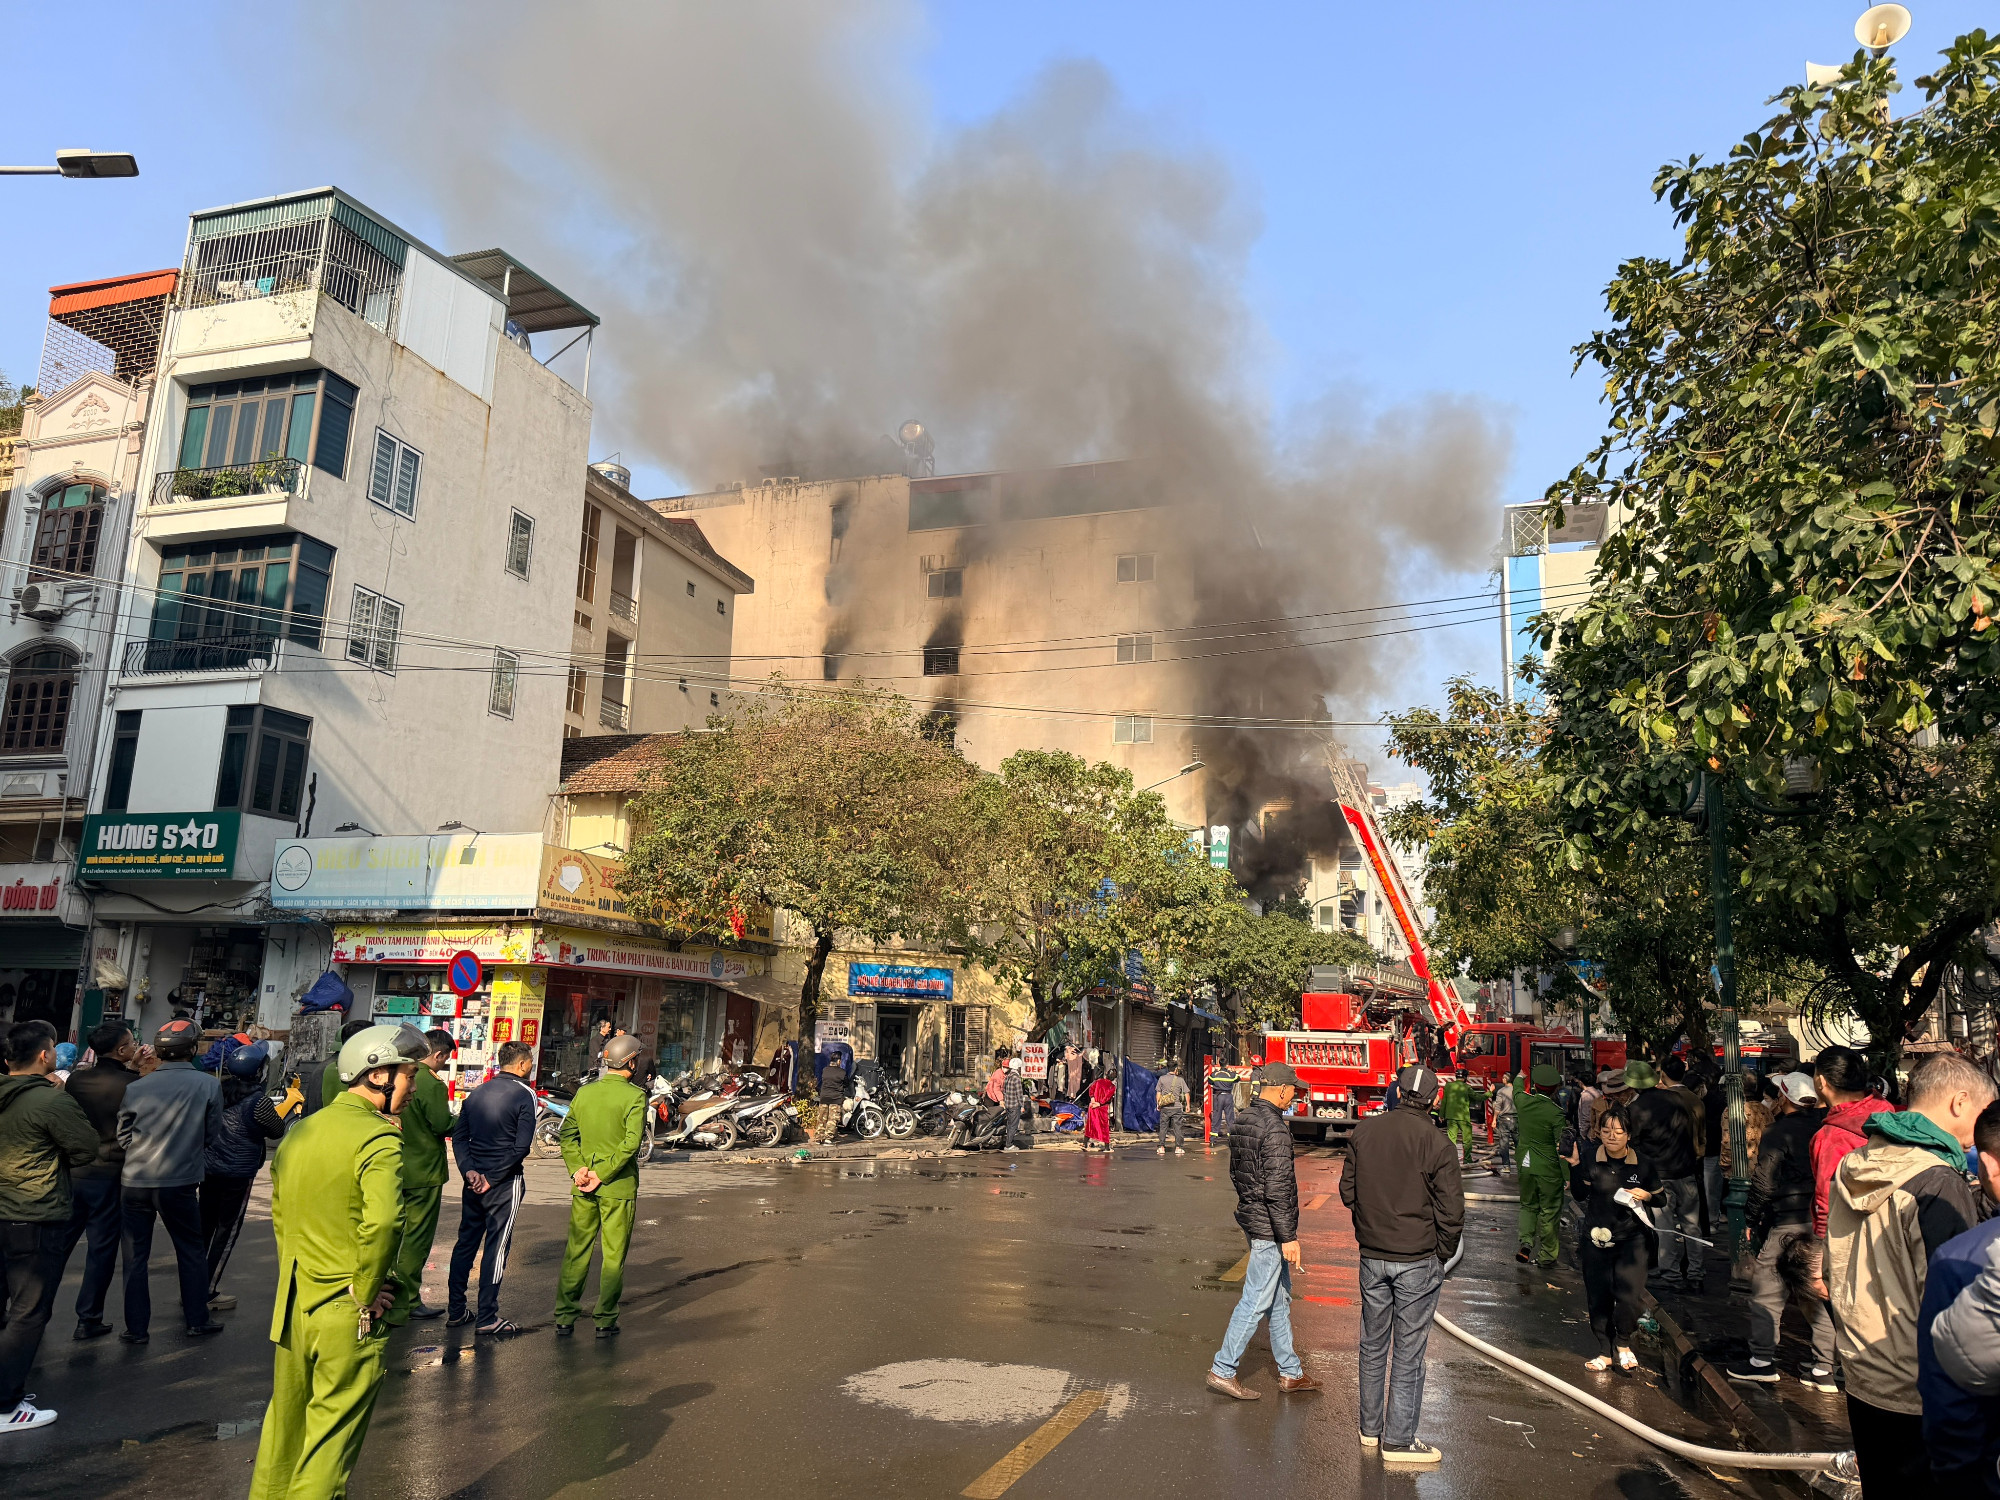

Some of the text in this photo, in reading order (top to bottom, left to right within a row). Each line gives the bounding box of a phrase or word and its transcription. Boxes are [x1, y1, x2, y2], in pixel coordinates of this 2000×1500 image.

[97, 822, 158, 850] HƯNG
[598, 895, 610, 911] BÁN
[365, 936, 386, 946] TRUNG
[388, 934, 402, 946] TÂM
[402, 934, 420, 946] PHÁT
[586, 947, 611, 963] TRUNG
[611, 948, 627, 965] TÂM
[627, 951, 645, 967] PHÁT
[645, 953, 664, 969] HÀNH
[665, 957, 671, 969] &
[671, 955, 684, 971] BÁN
[684, 958, 698, 975] LỊCH
[698, 957, 710, 974] TẾT
[916, 979, 928, 990] GIA
[1025, 1044, 1044, 1054] SỬA
